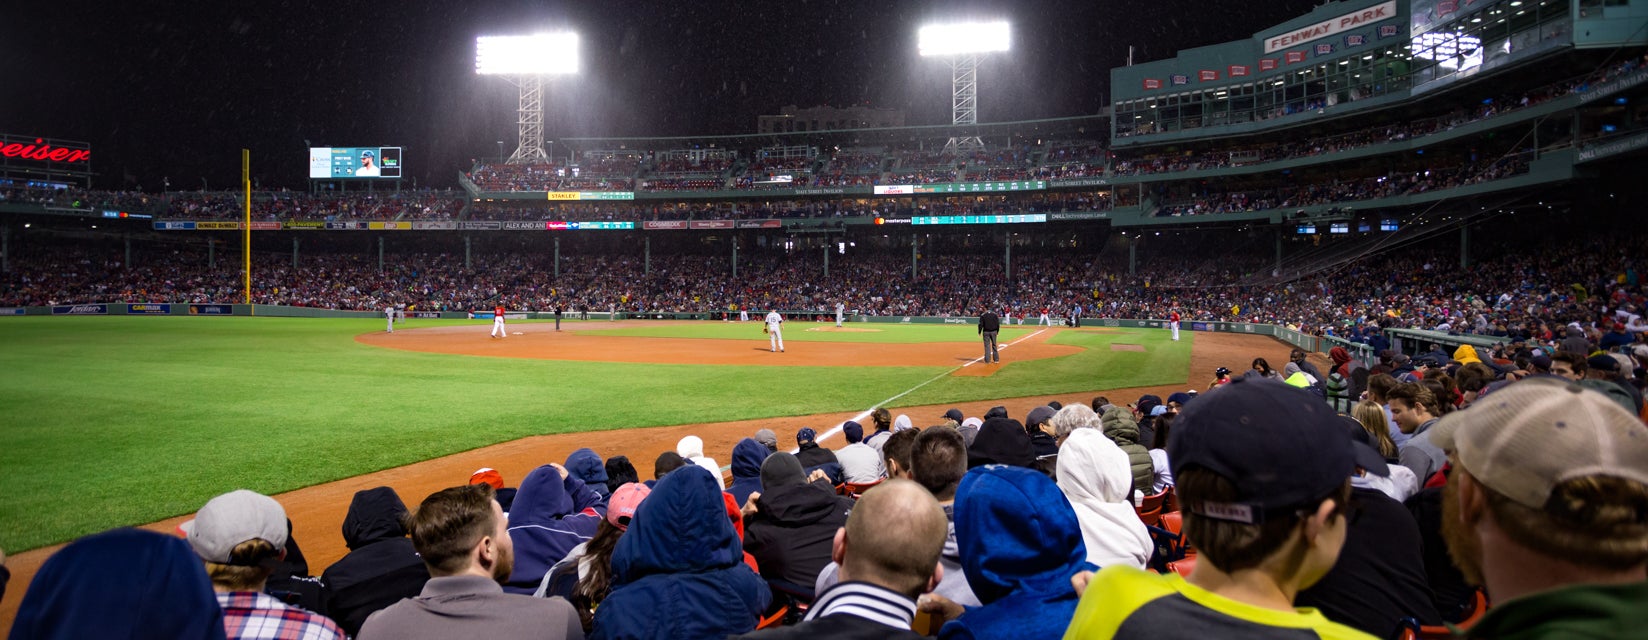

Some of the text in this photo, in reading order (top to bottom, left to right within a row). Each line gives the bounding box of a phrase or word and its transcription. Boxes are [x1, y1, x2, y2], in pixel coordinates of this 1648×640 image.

[1271, 6, 1385, 49] FENWAY PARK
[0, 138, 91, 162] eiser
